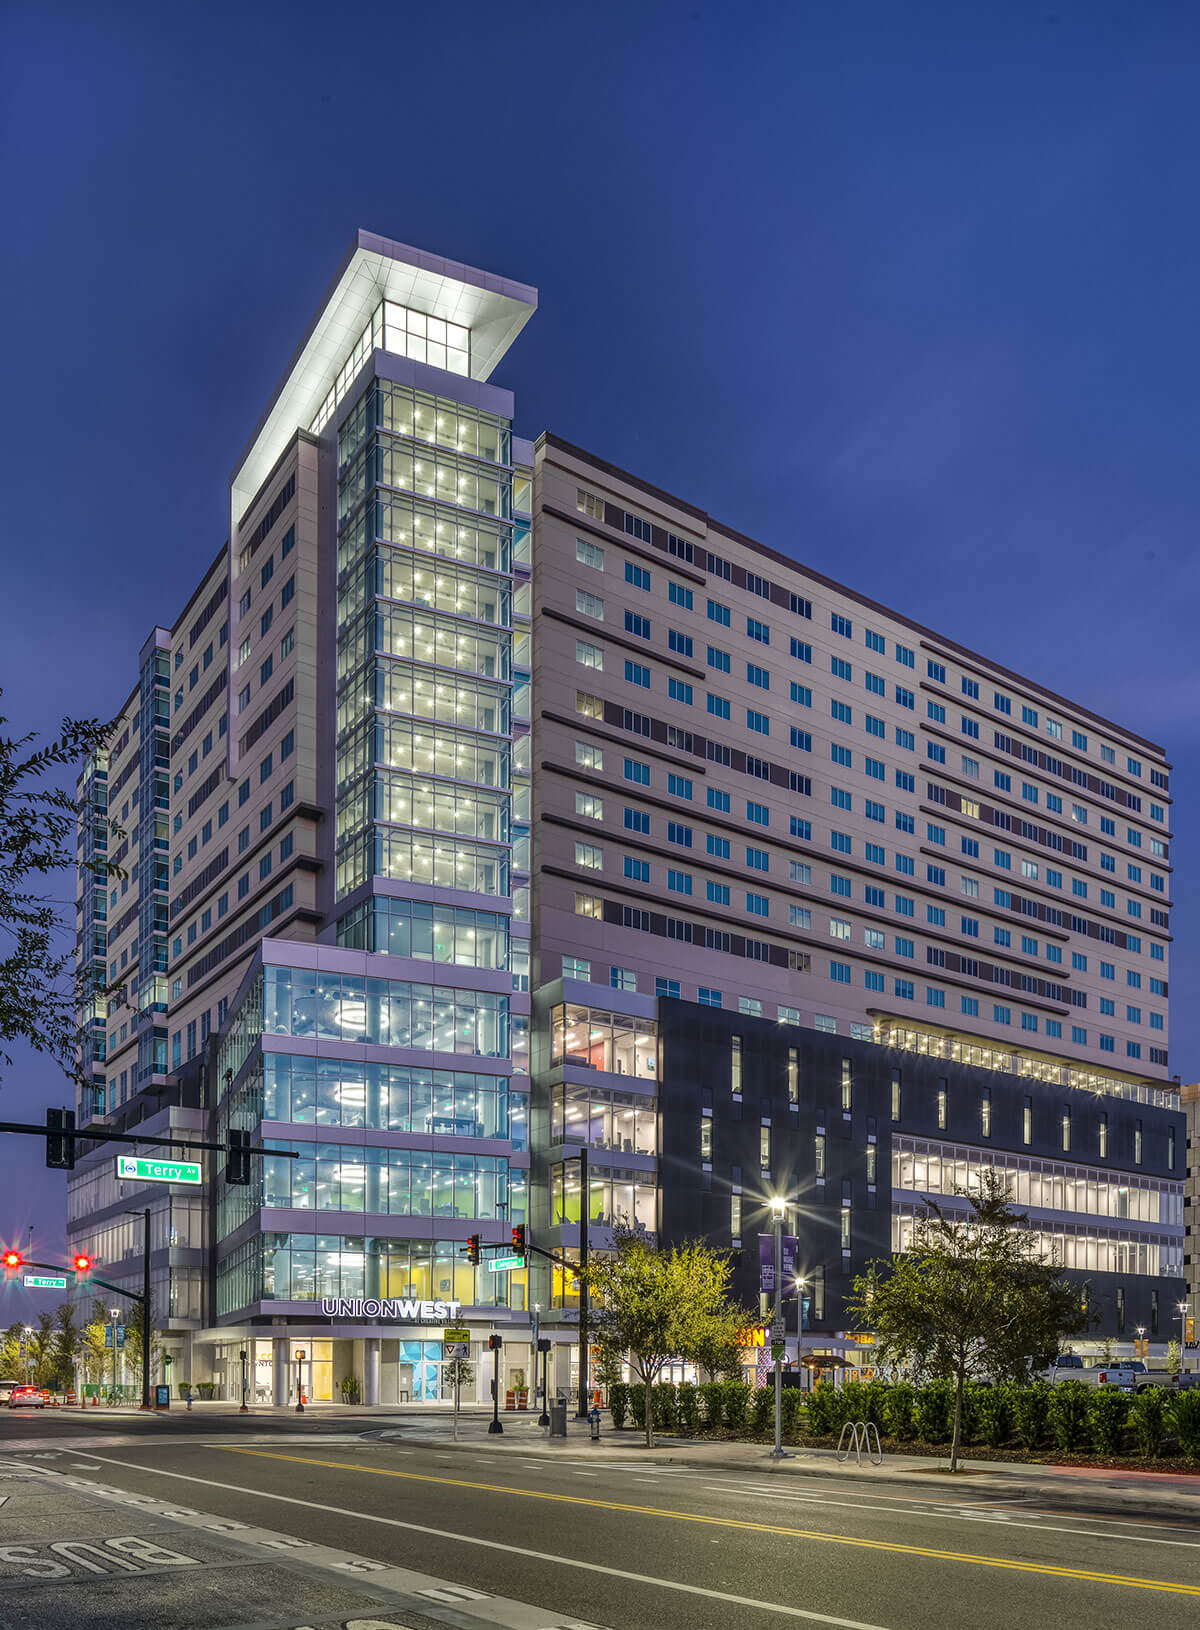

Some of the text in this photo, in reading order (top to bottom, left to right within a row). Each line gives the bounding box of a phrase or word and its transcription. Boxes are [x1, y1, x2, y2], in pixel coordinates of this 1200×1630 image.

[145, 1163, 182, 1180] Terry
[38, 1279, 56, 1287] Terry
[321, 1298, 461, 1319] UNIONWEST
[0, 1536, 202, 1578] BUS
